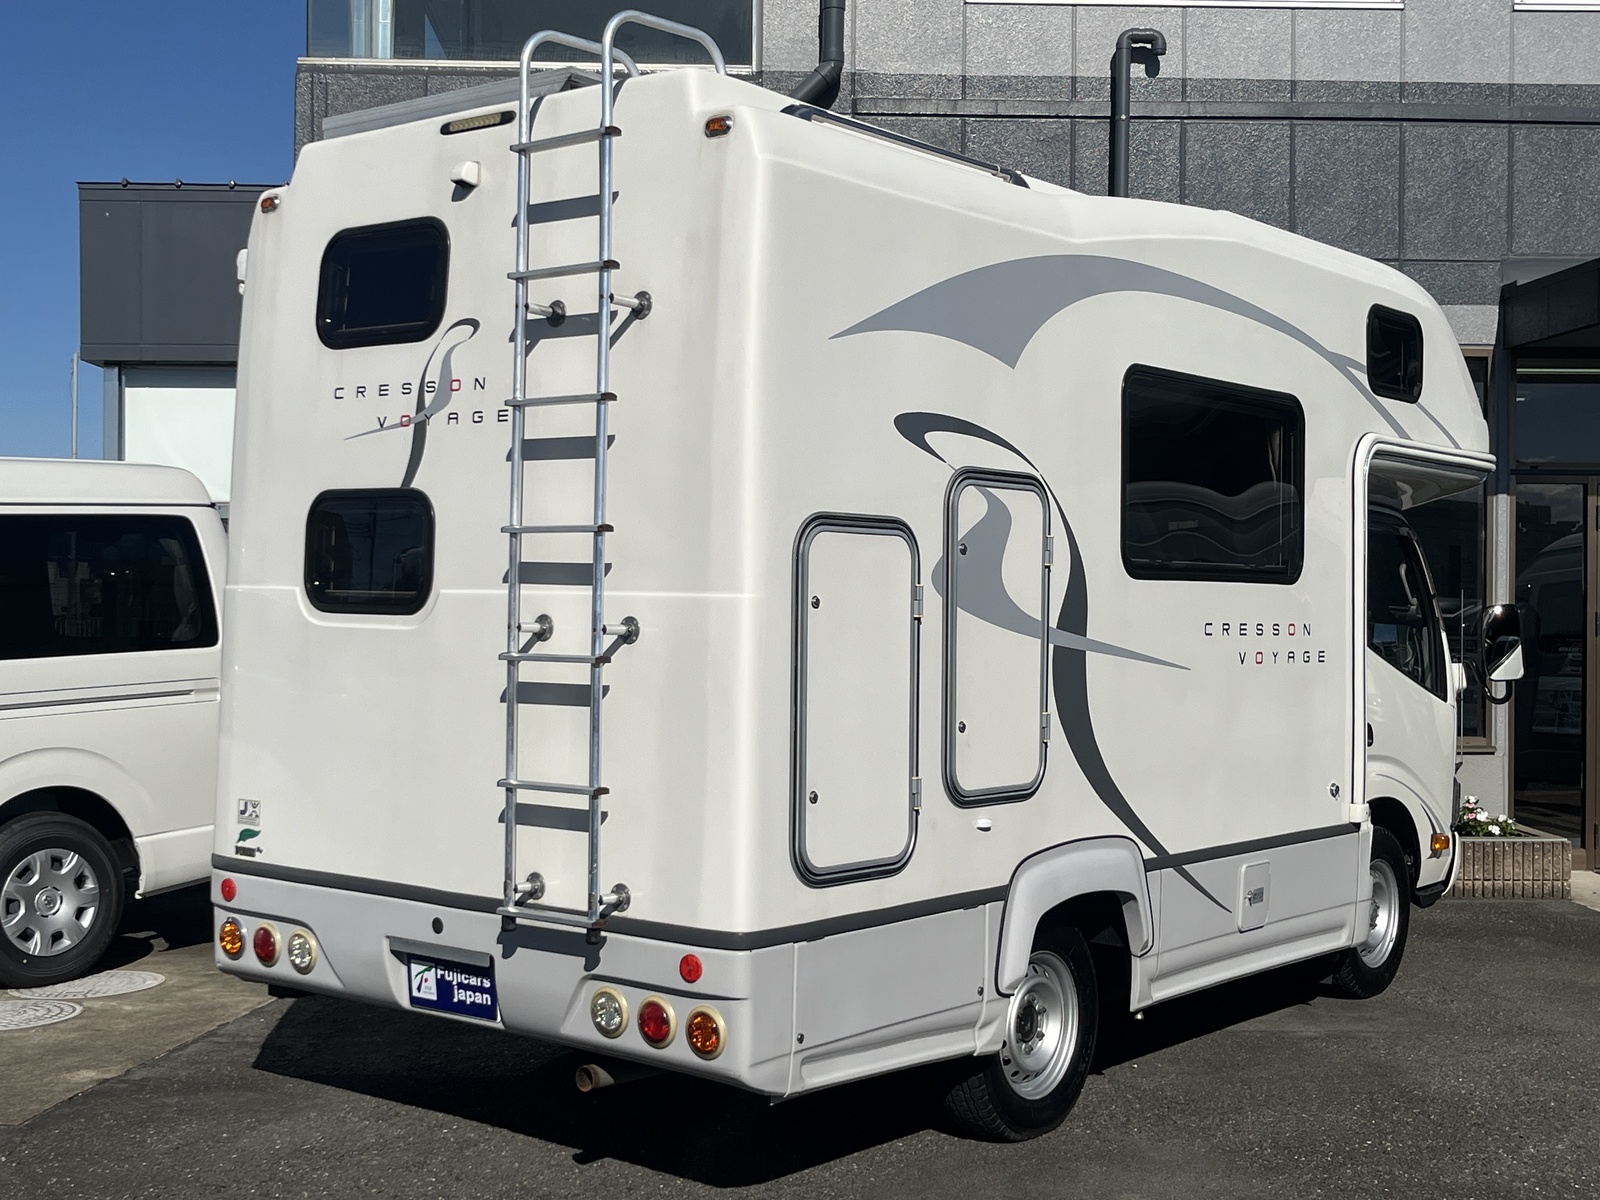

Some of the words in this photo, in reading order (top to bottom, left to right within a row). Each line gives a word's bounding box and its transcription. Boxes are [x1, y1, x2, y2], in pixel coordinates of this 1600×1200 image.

[334, 376, 487, 400] CRESSON
[377, 408, 510, 429] VOYAGE
[1204, 622, 1311, 637] CRESSON
[1238, 650, 1326, 665] VOYAGE
[436, 966, 492, 988] Fujicars
